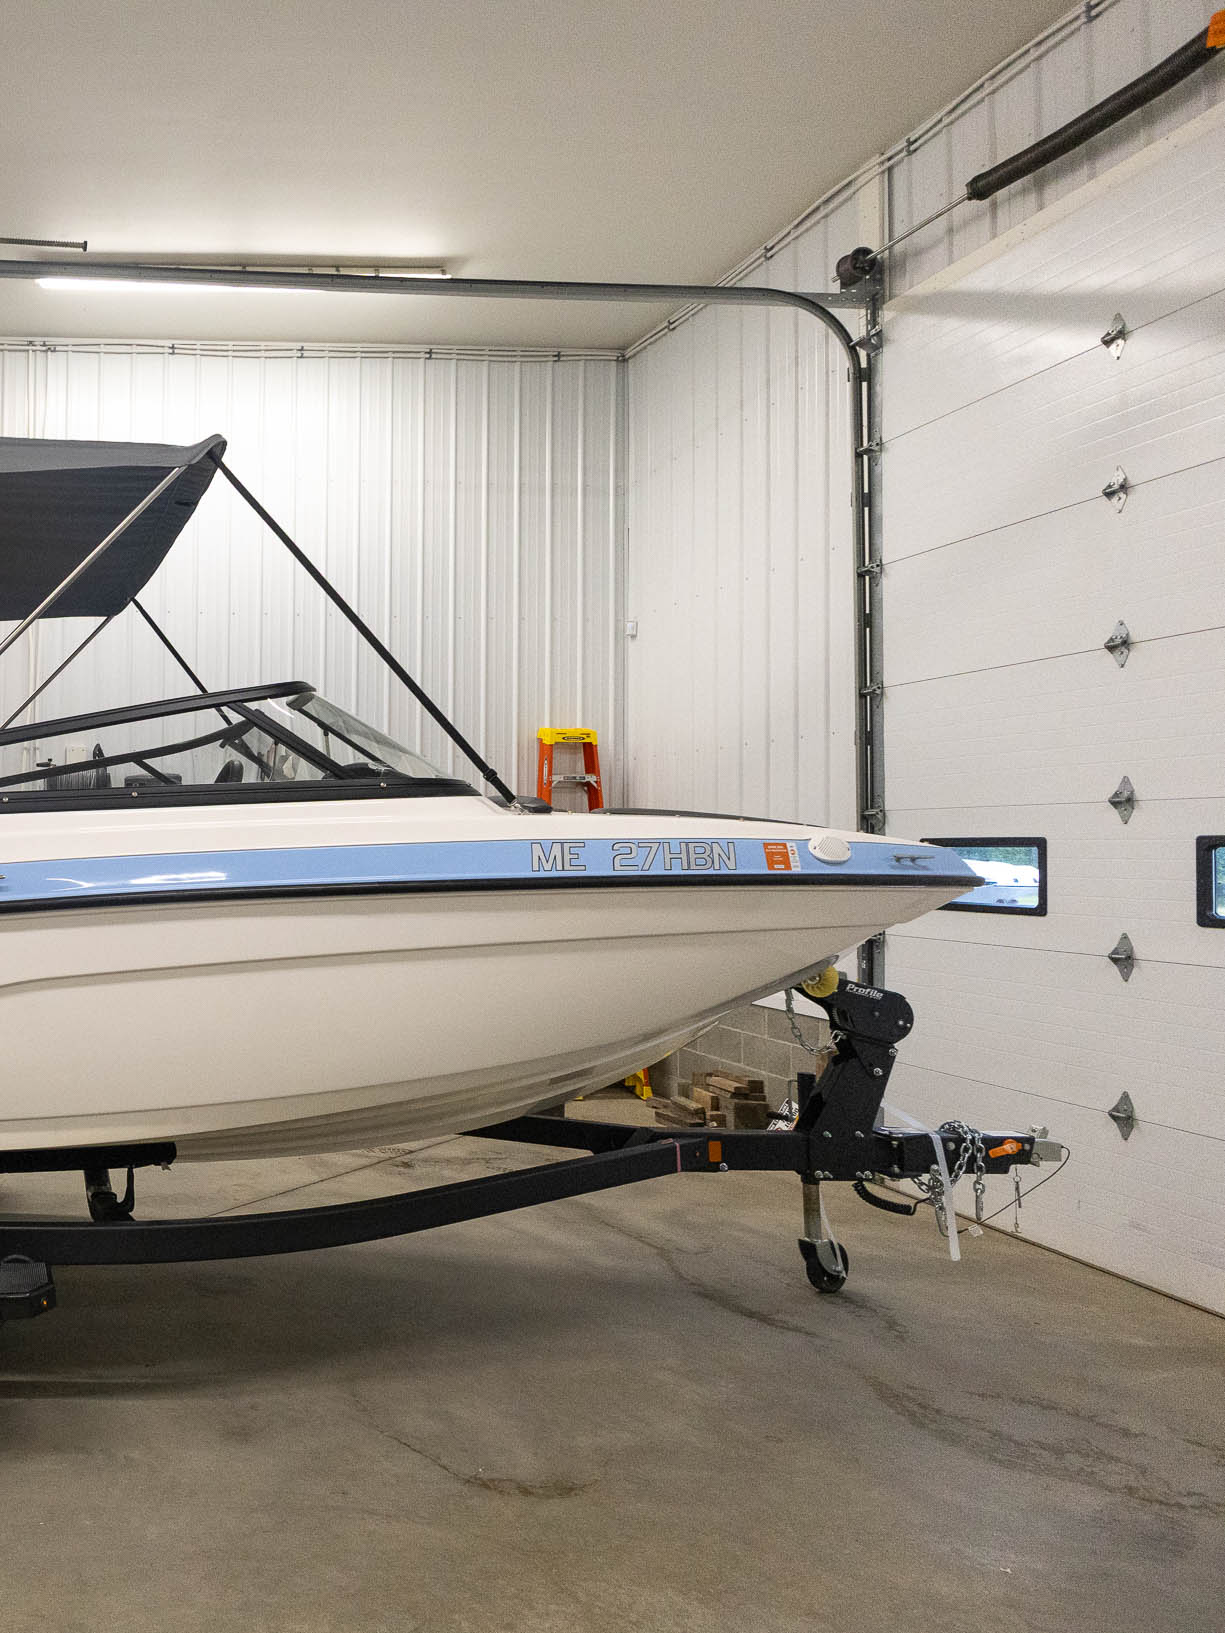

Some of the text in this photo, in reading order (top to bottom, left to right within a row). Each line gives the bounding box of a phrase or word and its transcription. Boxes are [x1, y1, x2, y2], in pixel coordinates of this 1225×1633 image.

[531, 842, 587, 872] ME
[612, 842, 737, 872] 27HBN
[846, 983, 884, 998] Profile
